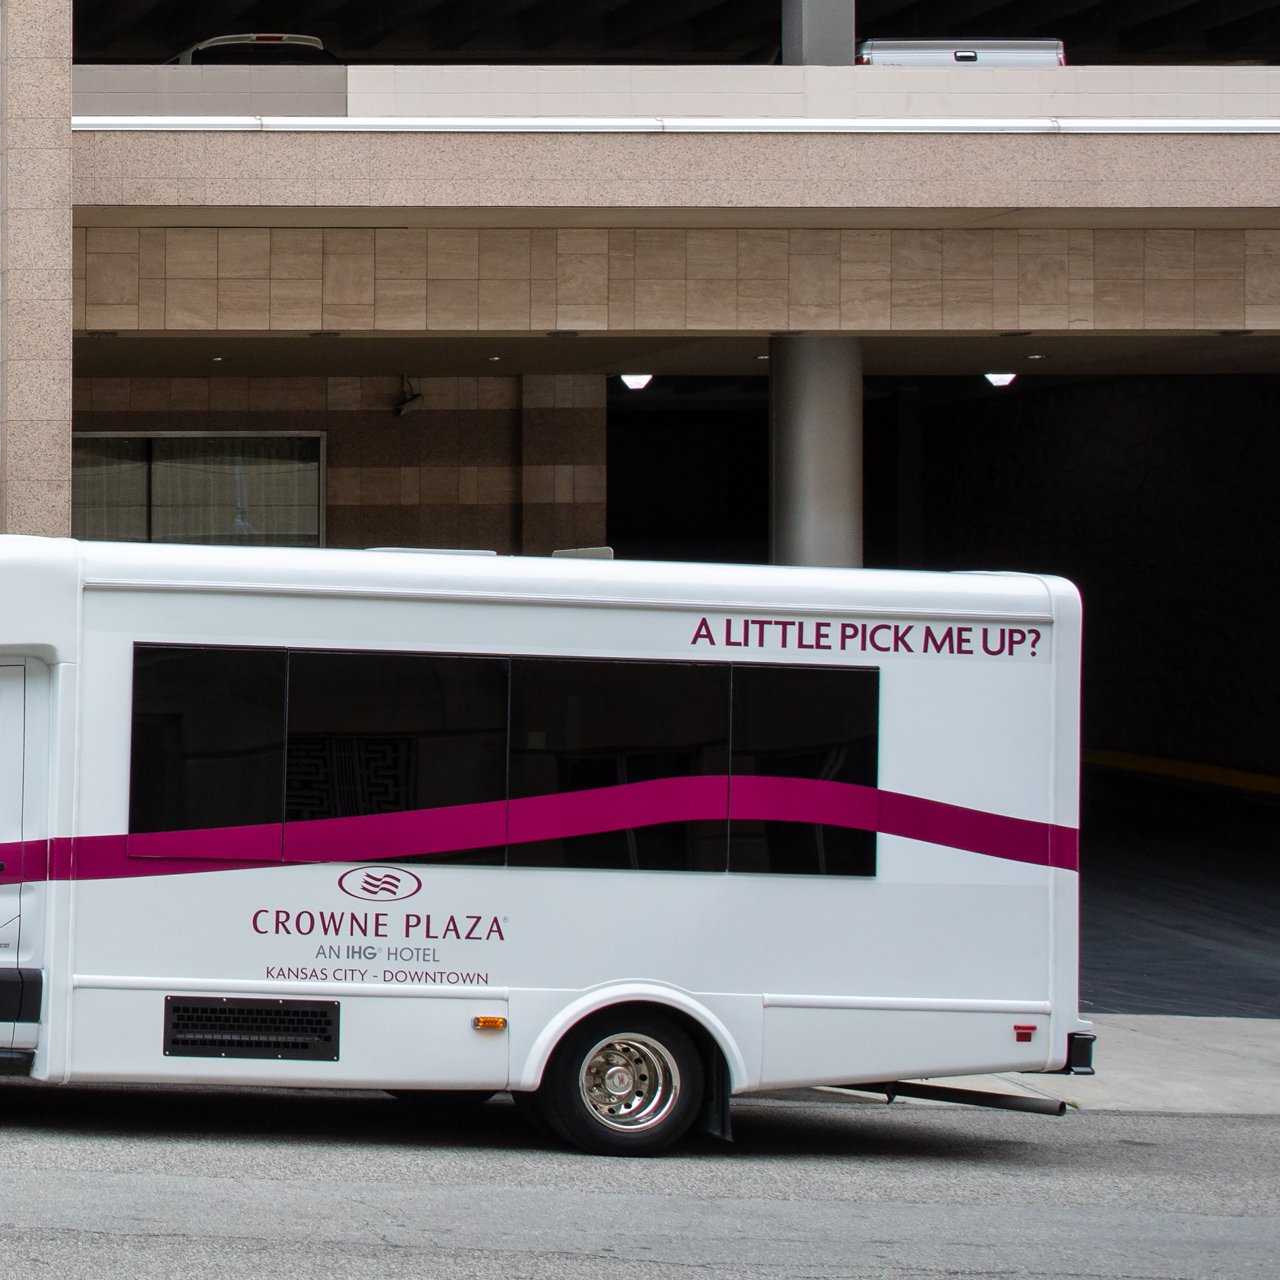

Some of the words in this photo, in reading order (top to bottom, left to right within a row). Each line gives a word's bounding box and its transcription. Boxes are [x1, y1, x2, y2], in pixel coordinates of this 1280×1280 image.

[690, 617, 716, 646] A
[725, 618, 832, 651] LITTLE
[840, 622, 915, 653] PICK
[922, 625, 974, 655] ME
[982, 628, 1042, 657] UP?
[252, 909, 389, 937] CROWNE
[315, 944, 341, 959] AN
[387, 946, 440, 962] HOTEL
[266, 966, 328, 981] KANSAS
[332, 968, 368, 982] CITY
[382, 969, 489, 985] DOWNTOWN
